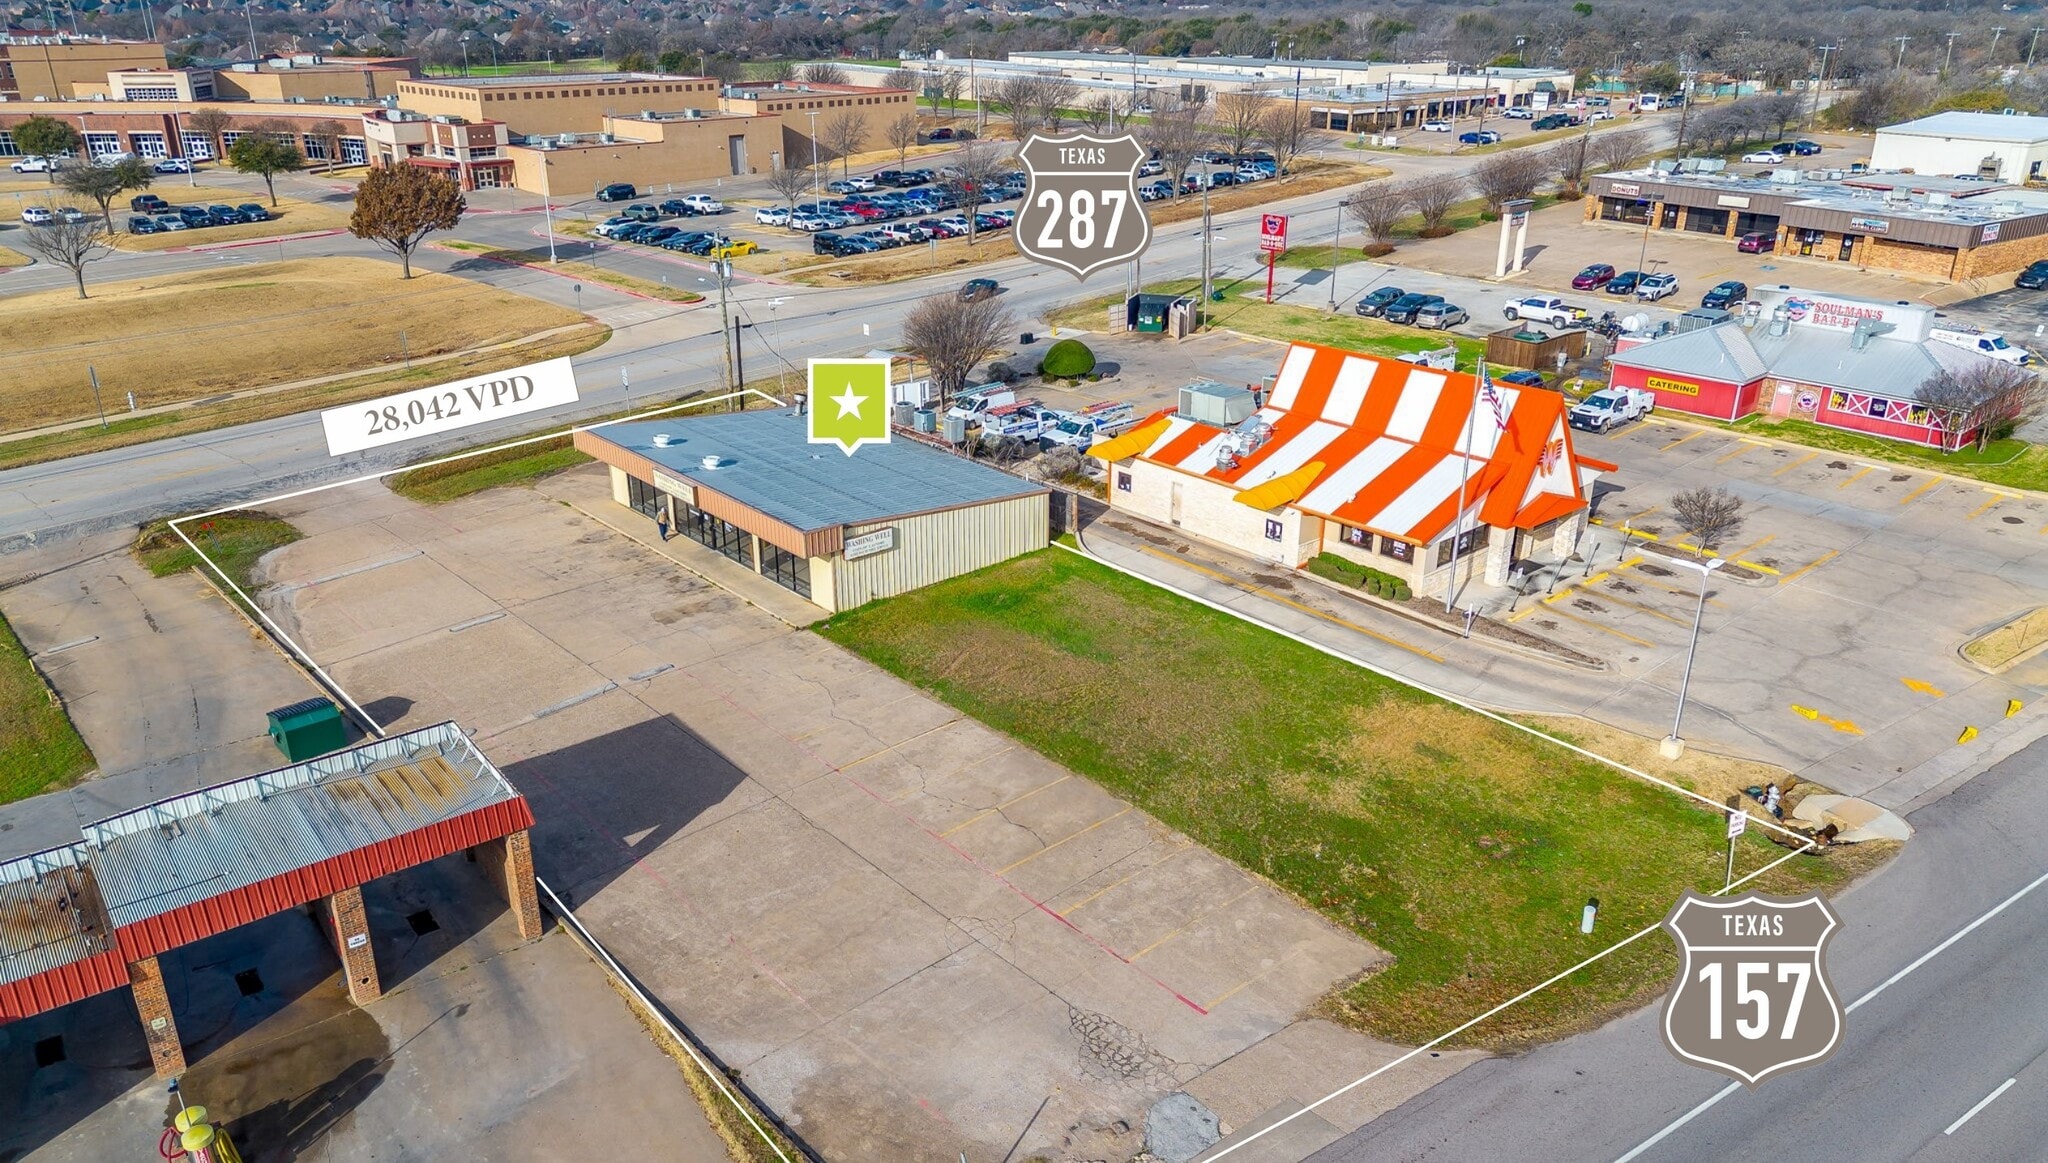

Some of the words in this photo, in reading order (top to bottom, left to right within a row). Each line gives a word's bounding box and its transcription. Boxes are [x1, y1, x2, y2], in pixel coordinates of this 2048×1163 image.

[1611, 186, 1638, 195] DONUTS
[1814, 302, 1884, 320] SOULMAN'S
[1649, 379, 1697, 394] CATERING
[846, 535, 873, 549] WASHING
